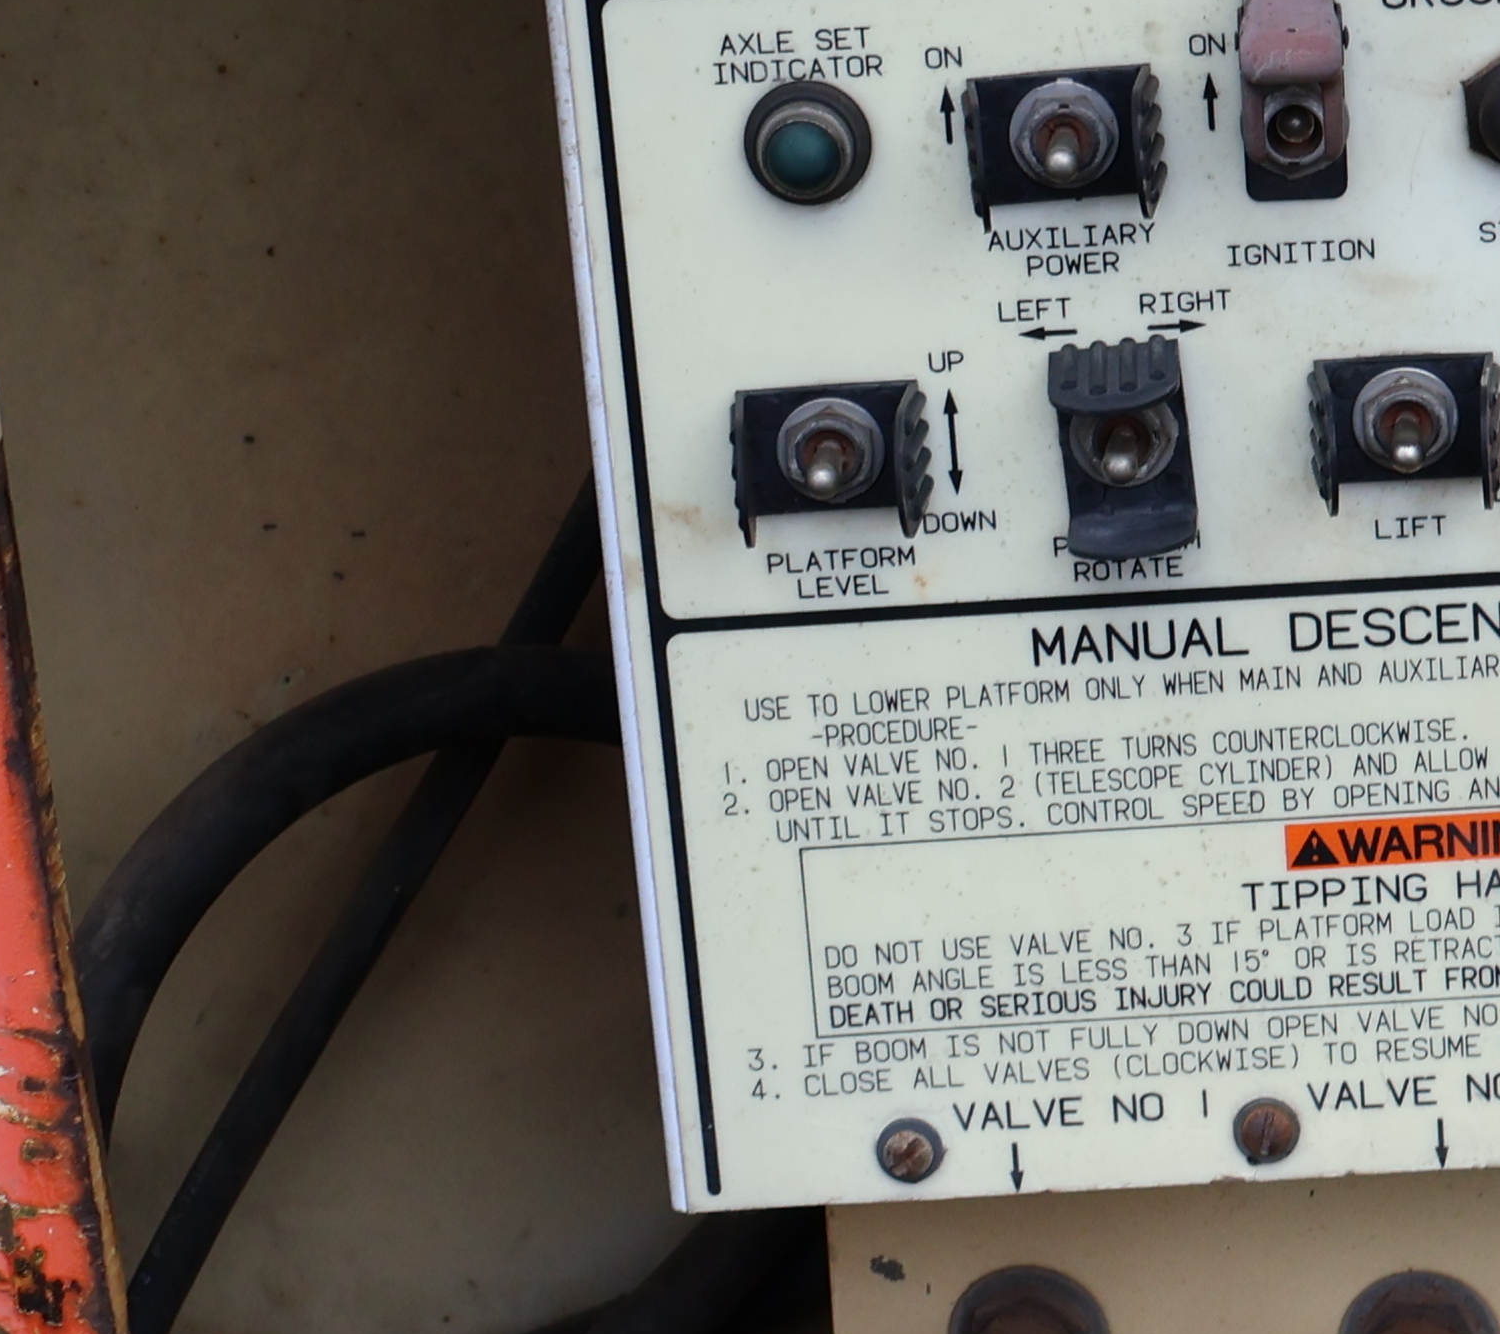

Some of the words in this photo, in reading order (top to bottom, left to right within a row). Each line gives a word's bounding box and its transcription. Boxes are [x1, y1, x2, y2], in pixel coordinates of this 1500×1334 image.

[720, 31, 794, 56] AXLE
[815, 27, 870, 51] SET
[1189, 33, 1226, 56] ON
[713, 55, 882, 85] INDICATOR
[925, 46, 962, 69] ON
[989, 222, 1155, 251] AUXILIARY
[1027, 251, 1119, 277] POWER
[1227, 239, 1375, 267] IGNITION
[998, 298, 1070, 322] LEFT
[1140, 289, 1230, 314] RIGHT
[928, 351, 964, 373] UP
[923, 510, 997, 534] DOWN
[1375, 515, 1446, 539] LIFT
[767, 546, 915, 573] PLATFORM
[1073, 556, 1184, 581] ROTATE
[797, 574, 889, 599] LEVEL
[1032, 617, 1249, 667] MANUAL
[744, 696, 791, 721] USE
[807, 693, 838, 717] TO
[854, 688, 929, 715] LOWER
[946, 679, 1069, 709] PLATFORM
[1086, 675, 1145, 701] ONLY
[1163, 670, 1223, 696] WHEN
[1240, 666, 1300, 691] MAIN
[1318, 662, 1362, 687] AND
[812, 716, 976, 747] -PROCEDURE-
[1242, 873, 1427, 911] TIPPING
[830, 1000, 913, 1028] DEATH
[930, 997, 962, 1021] OR
[980, 989, 1096, 1018] SERIOUS
[1115, 982, 1211, 1010] INJURY
[1230, 976, 1312, 1003] COULD
[1329, 969, 1427, 997] RESULT
[1307, 1076, 1437, 1111] VALVE
[953, 1097, 1084, 1131] VALVE
[1113, 1092, 1164, 1123] NO
[1202, 1089, 1208, 1118] 1
